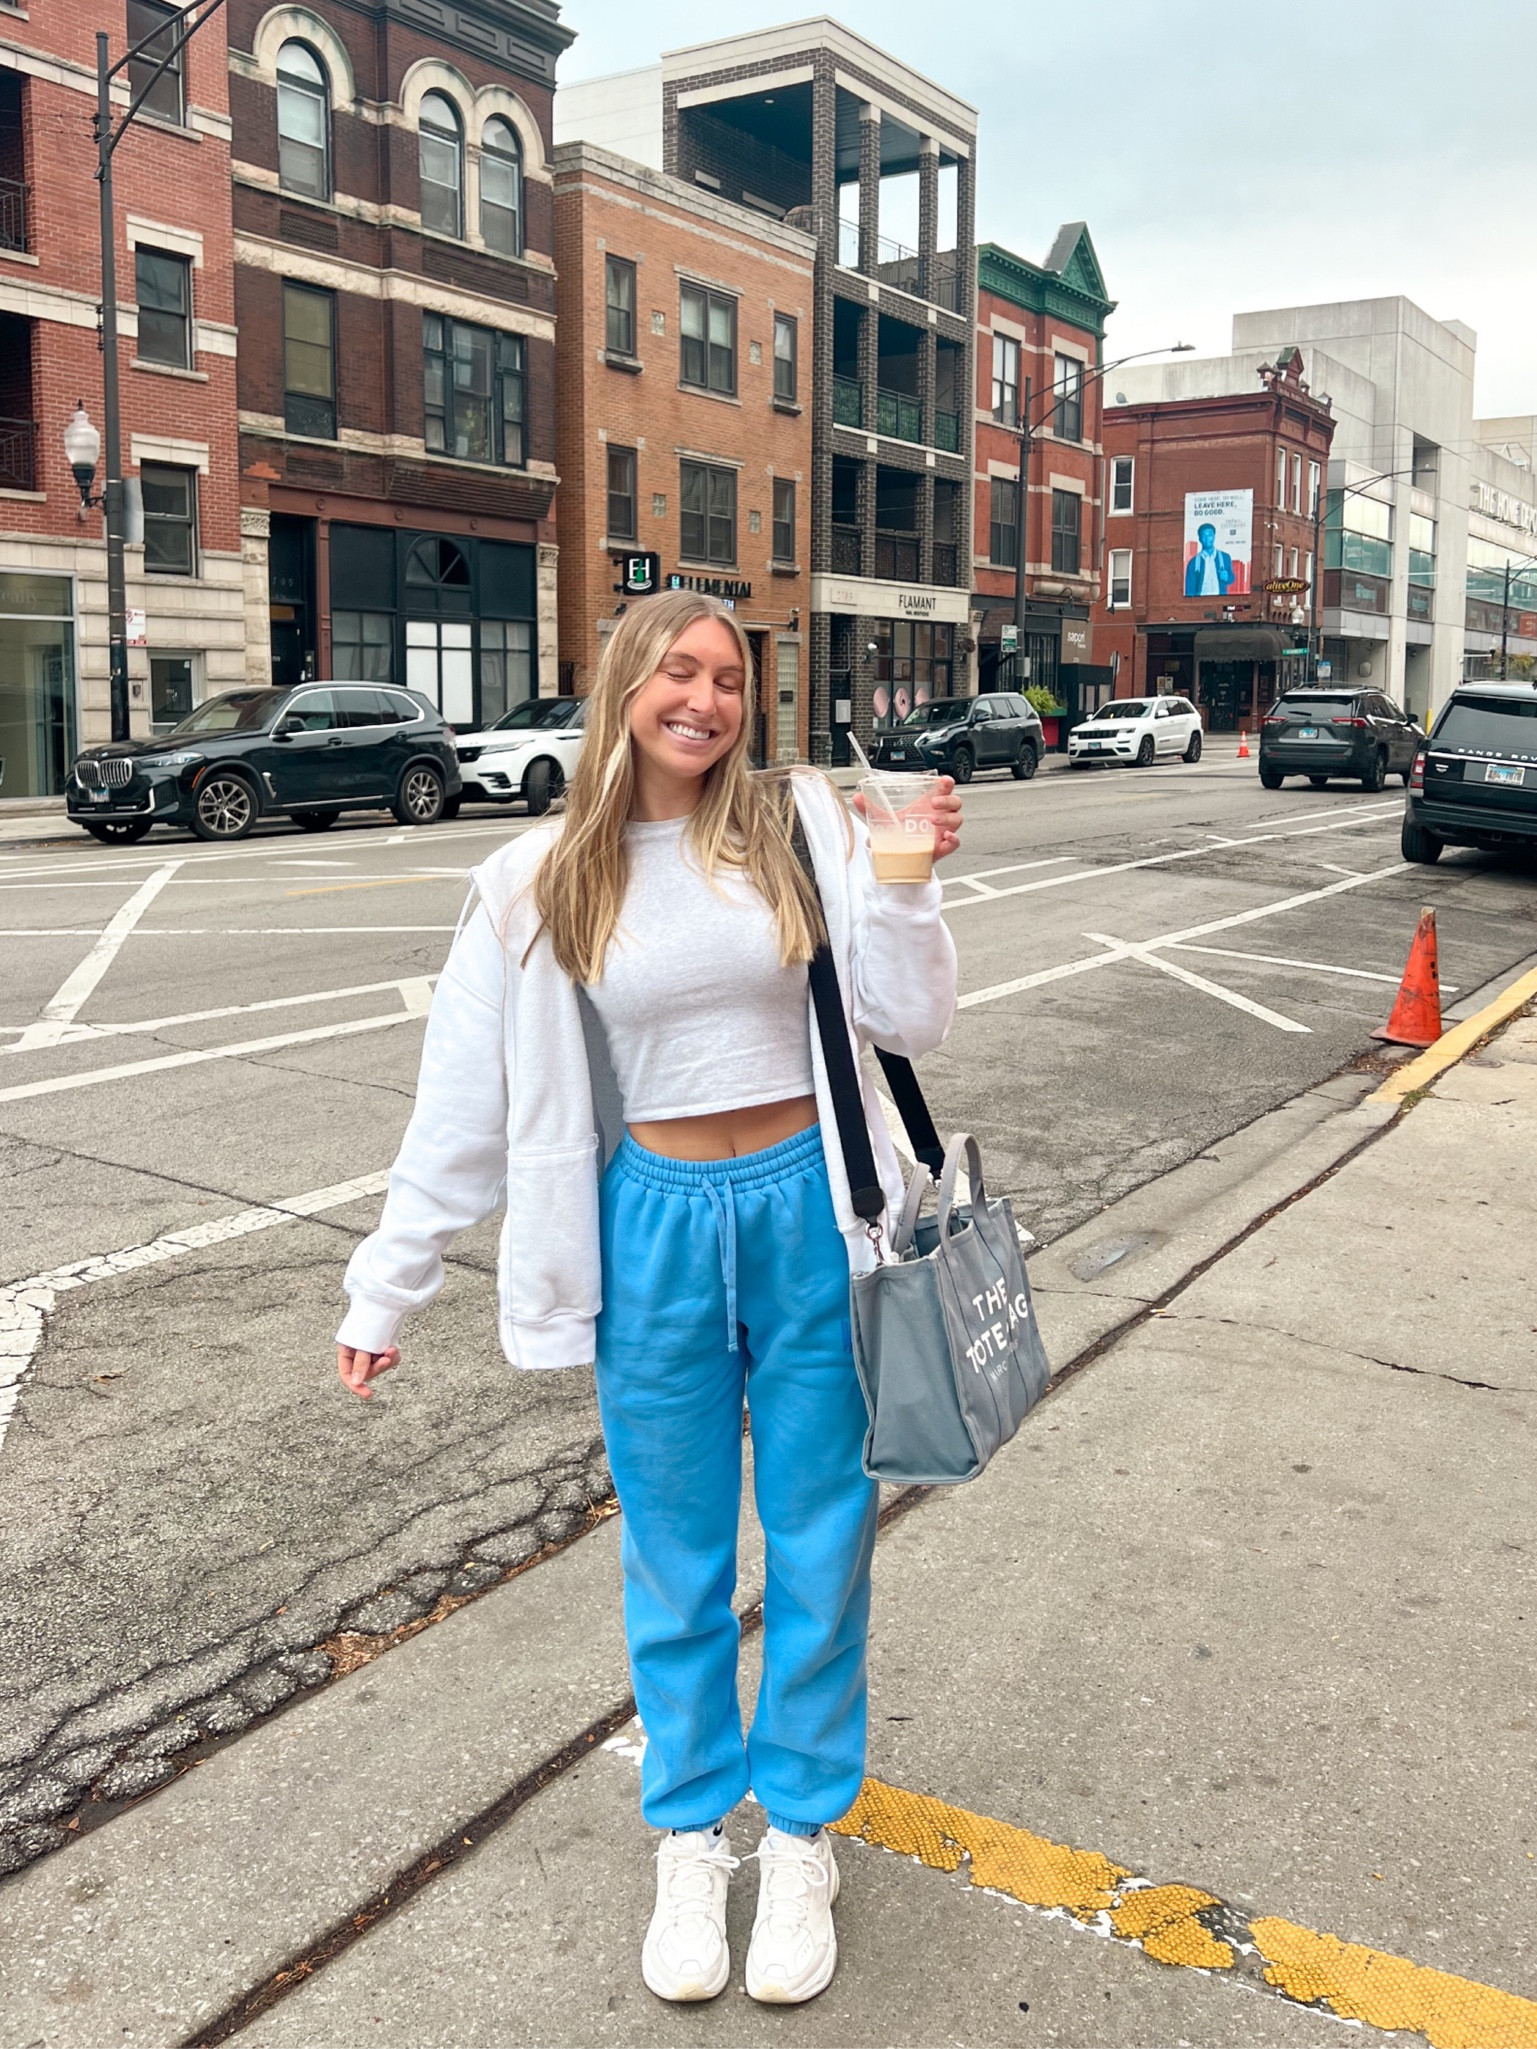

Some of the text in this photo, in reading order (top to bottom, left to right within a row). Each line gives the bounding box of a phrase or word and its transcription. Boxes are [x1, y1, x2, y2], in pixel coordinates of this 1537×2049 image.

[1479, 483, 1496, 513] THE
[1497, 491, 1520, 524] HOME
[1266, 579, 1305, 590] aliveOne
[898, 594, 937, 611] FLAMANT
[1458, 747, 1503, 758] RANGE
[972, 1277, 1008, 1321] THE
[966, 1321, 1008, 1374] TOTE
[1006, 1293, 1028, 1334] AG
